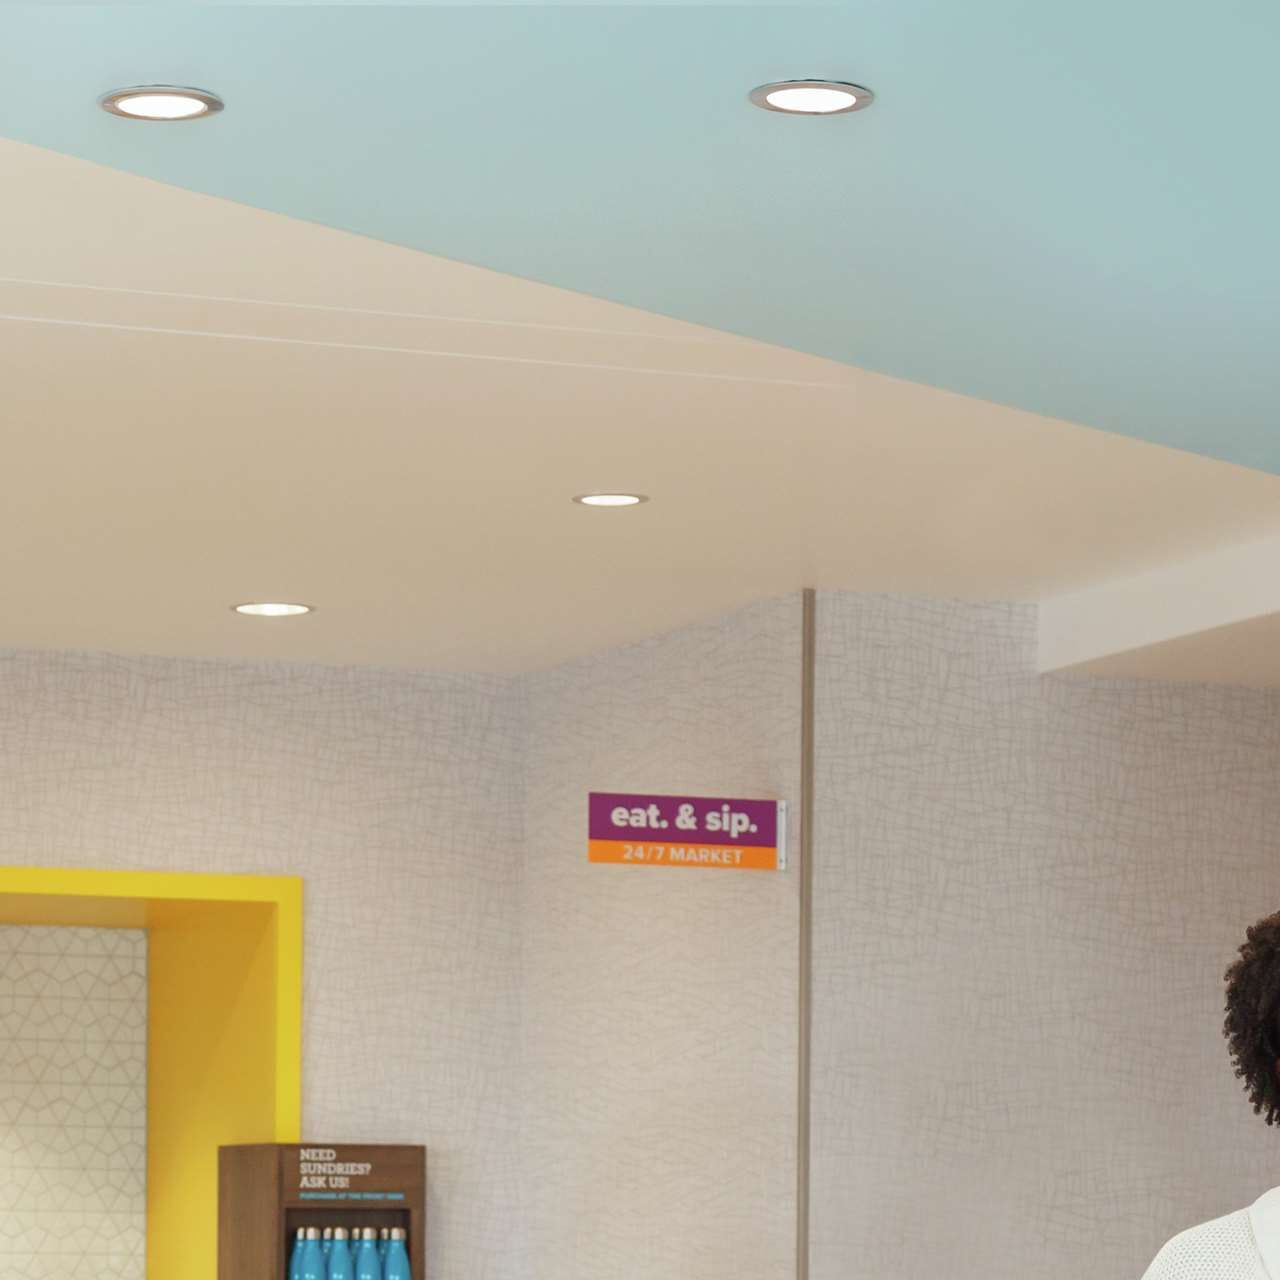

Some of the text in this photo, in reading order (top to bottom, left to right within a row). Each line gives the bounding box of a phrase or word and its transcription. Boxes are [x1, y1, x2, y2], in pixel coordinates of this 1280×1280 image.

[610, 804, 758, 839] eat. & sip.
[623, 845, 744, 864] 24/7 MARKET
[300, 1149, 336, 1161] NEED
[300, 1163, 372, 1175] SUNDRIES?
[300, 1177, 326, 1188] ASK
